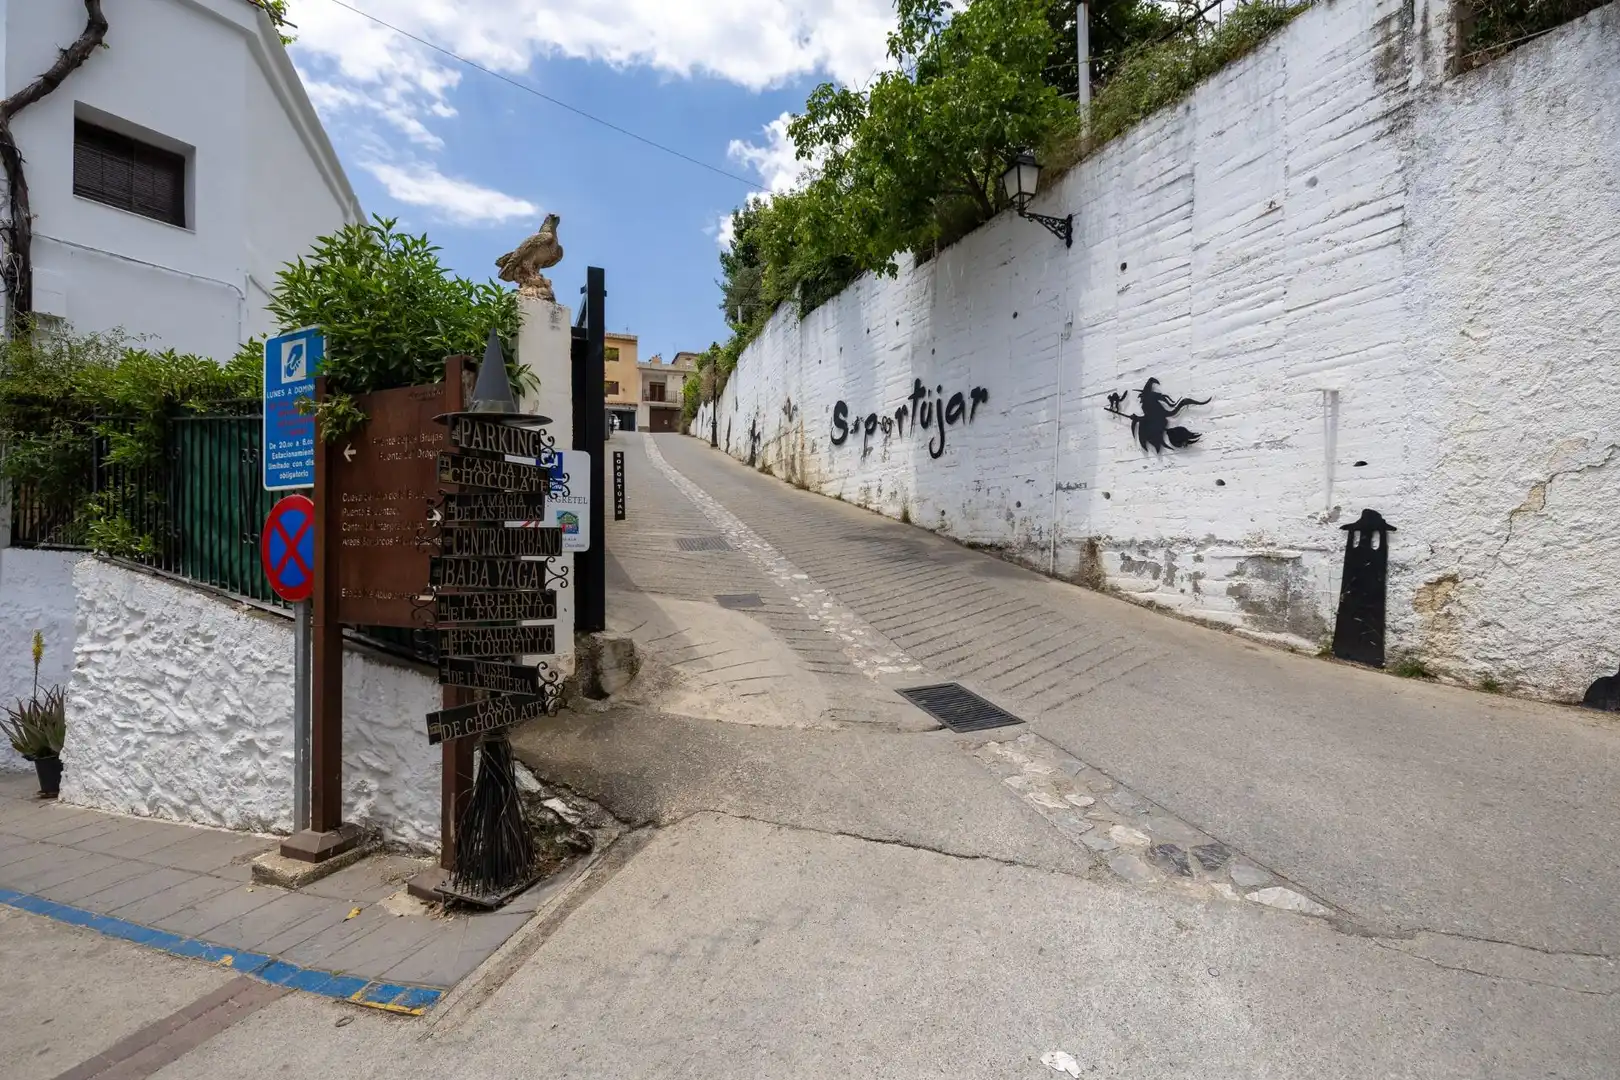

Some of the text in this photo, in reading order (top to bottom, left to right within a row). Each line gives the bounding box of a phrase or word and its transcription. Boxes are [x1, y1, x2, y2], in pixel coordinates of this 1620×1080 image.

[267, 384, 315, 399] LUNES A DOMIN
[460, 418, 539, 457] PARKING
[269, 442, 276, 450] De
[271, 449, 315, 460] Estacionamient
[268, 461, 290, 470] limitado
[305, 458, 315, 466] dis
[463, 457, 539, 479] CASITA DE
[279, 470, 309, 480] obligatorio
[451, 467, 549, 492] CHOCOLATE
[471, 493, 526, 507] LA MAGIA
[555, 496, 588, 505] GRETEL
[455, 505, 542, 520] DE LAS BRUJAS
[454, 528, 506, 555] CENTRO
[508, 528, 561, 555] URBANO
[445, 559, 539, 589] BABA YAGA
[460, 592, 544, 608] TABERNA
[450, 603, 555, 621] EL EMBRUJO
[451, 627, 553, 642] RESTAURANTE
[452, 641, 468, 656] EL
[451, 670, 464, 684] DE
[467, 672, 480, 687] LA
[477, 695, 515, 716] CASA
[441, 701, 543, 741] DE CHOCOLATE
